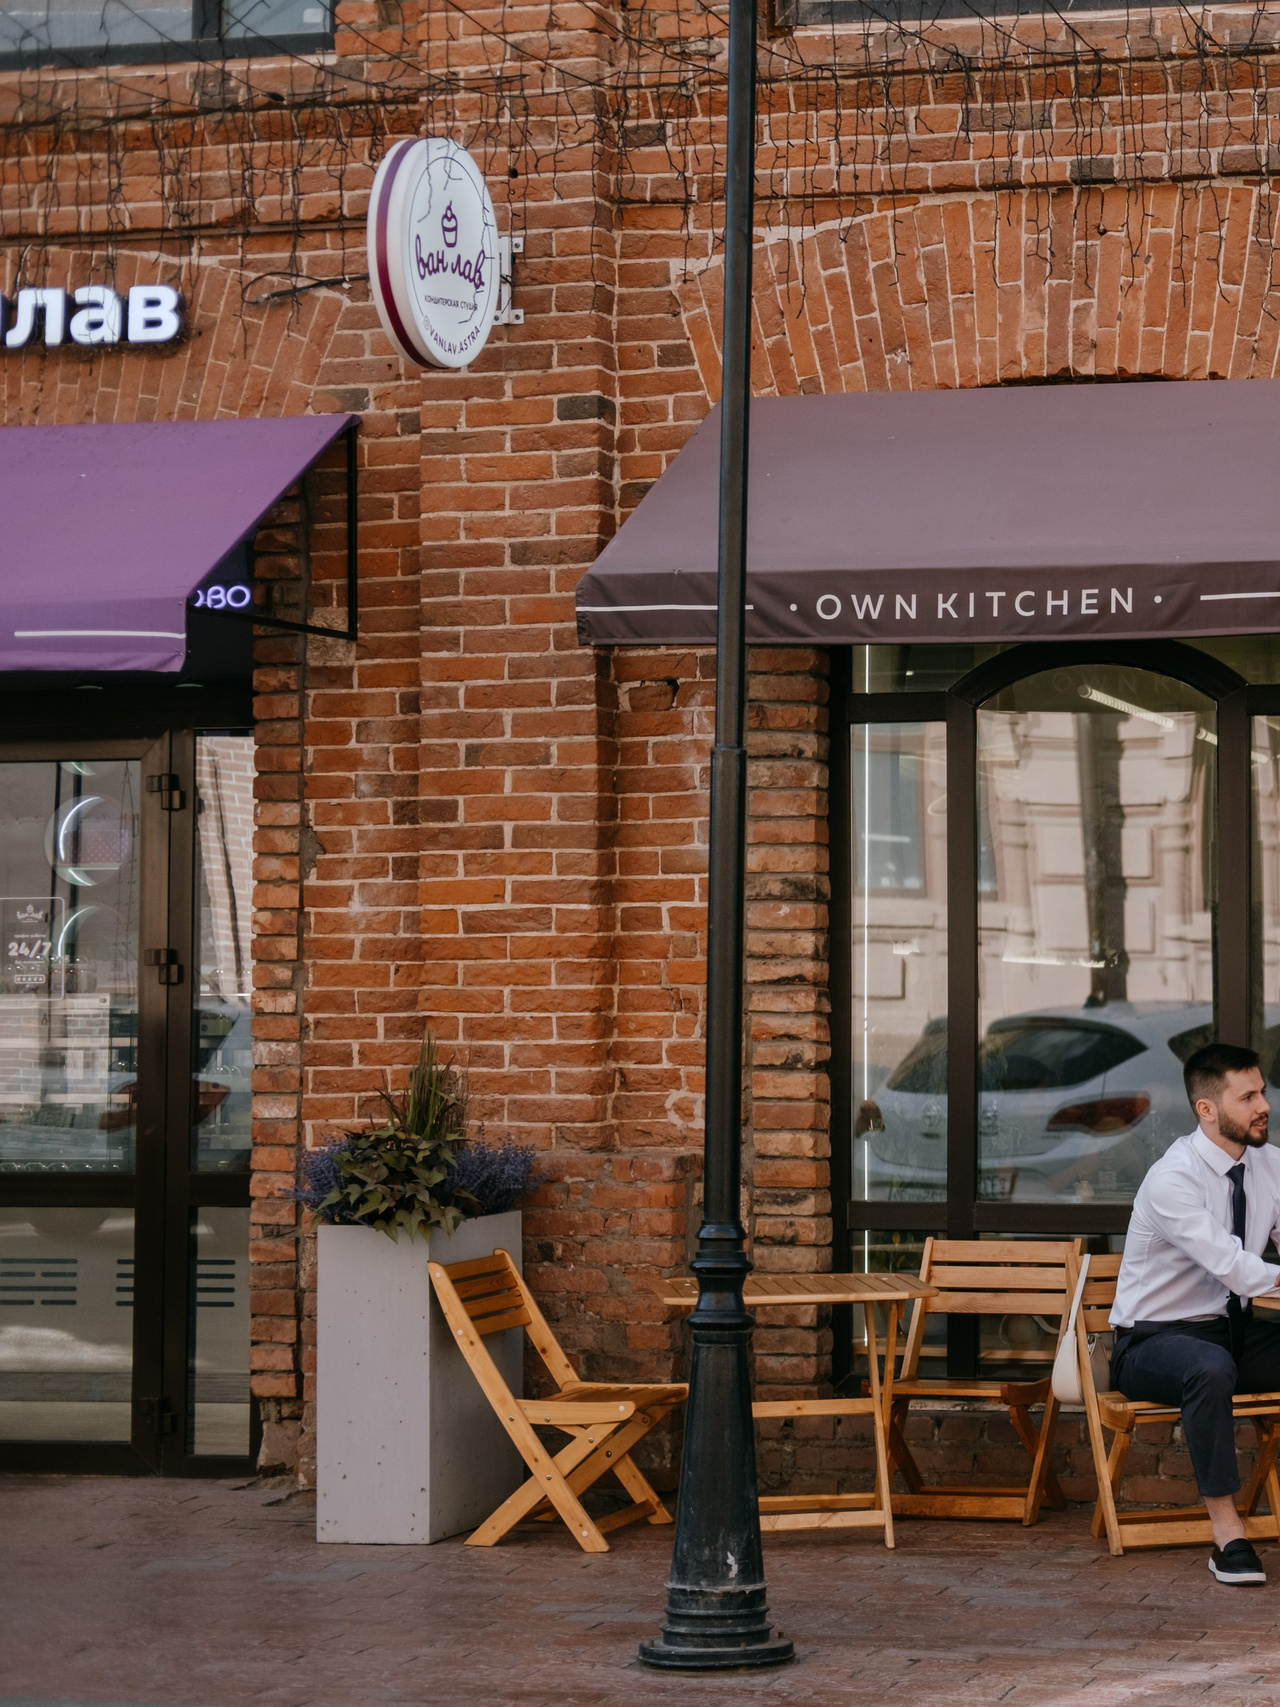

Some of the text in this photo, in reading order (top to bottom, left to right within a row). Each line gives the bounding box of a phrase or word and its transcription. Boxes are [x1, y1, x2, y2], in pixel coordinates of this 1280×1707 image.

[0, 286, 179, 347] лав
[816, 587, 1133, 620] OWN KITCHEN
[8, 940, 52, 958] 24/7
